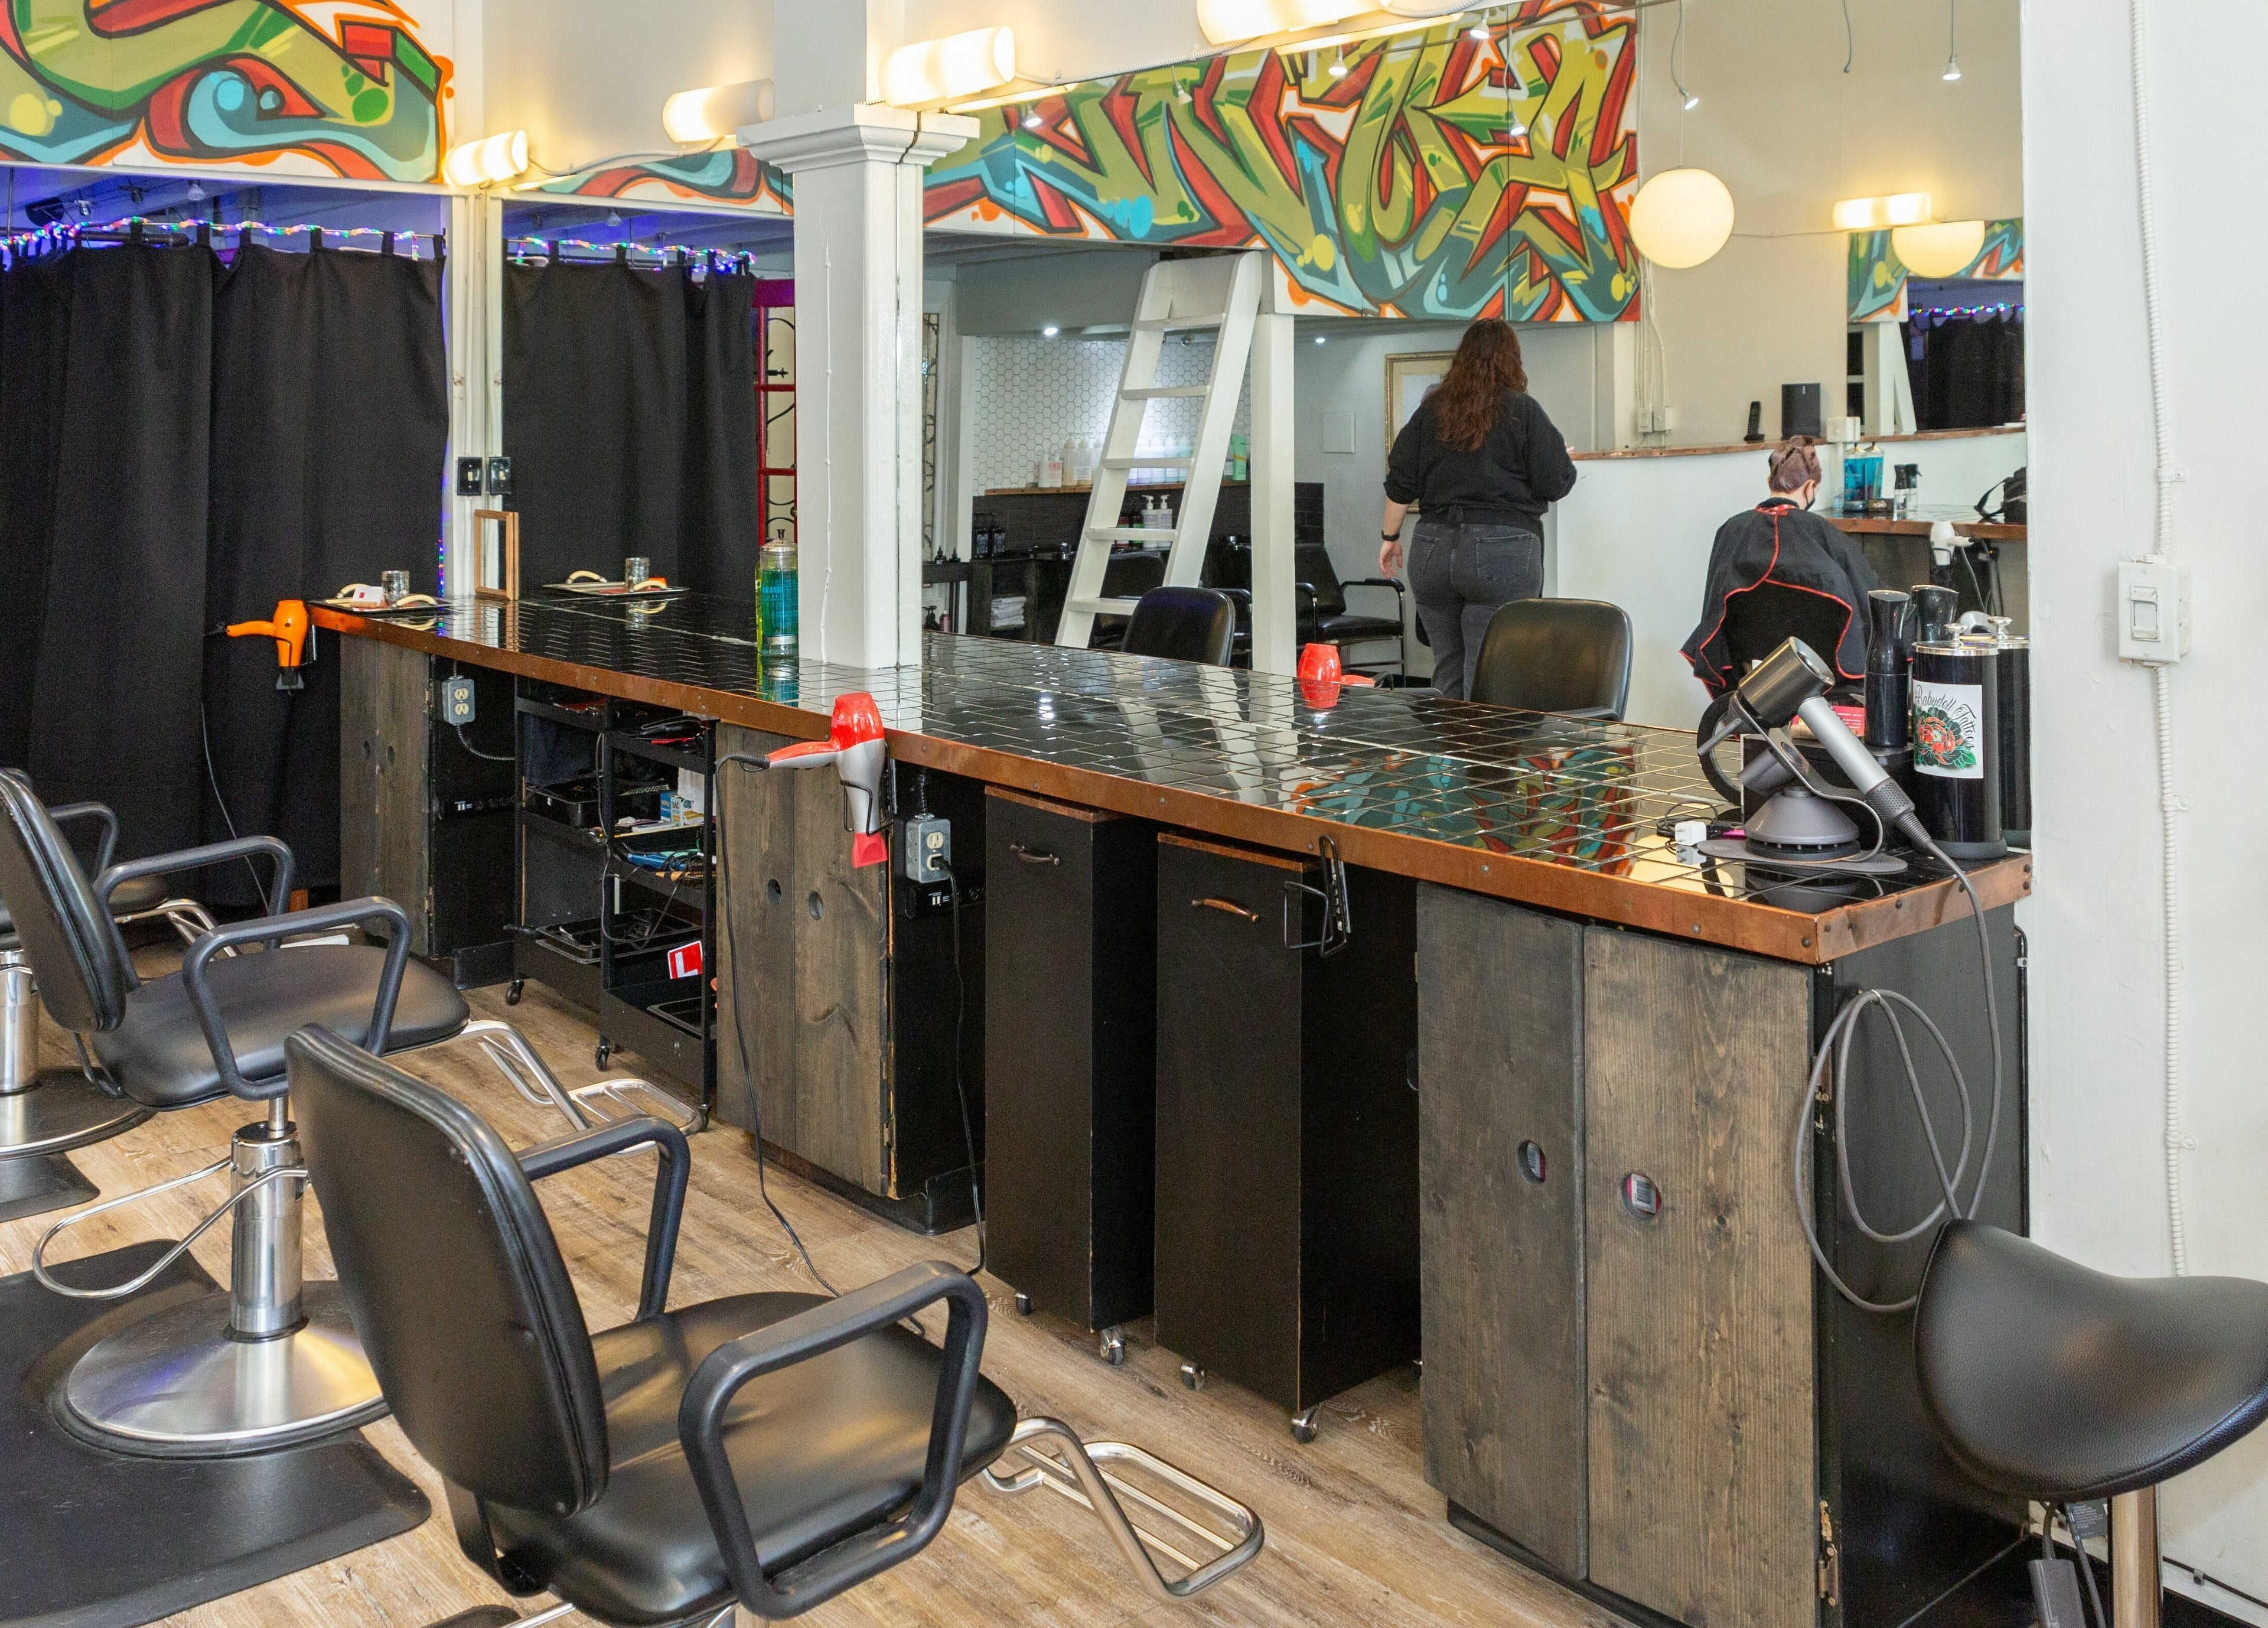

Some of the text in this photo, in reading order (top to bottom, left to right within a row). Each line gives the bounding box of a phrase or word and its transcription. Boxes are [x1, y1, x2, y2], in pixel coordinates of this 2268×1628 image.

[1914, 684, 1977, 750] Babydoll Tattoos
[674, 951, 699, 978] L
